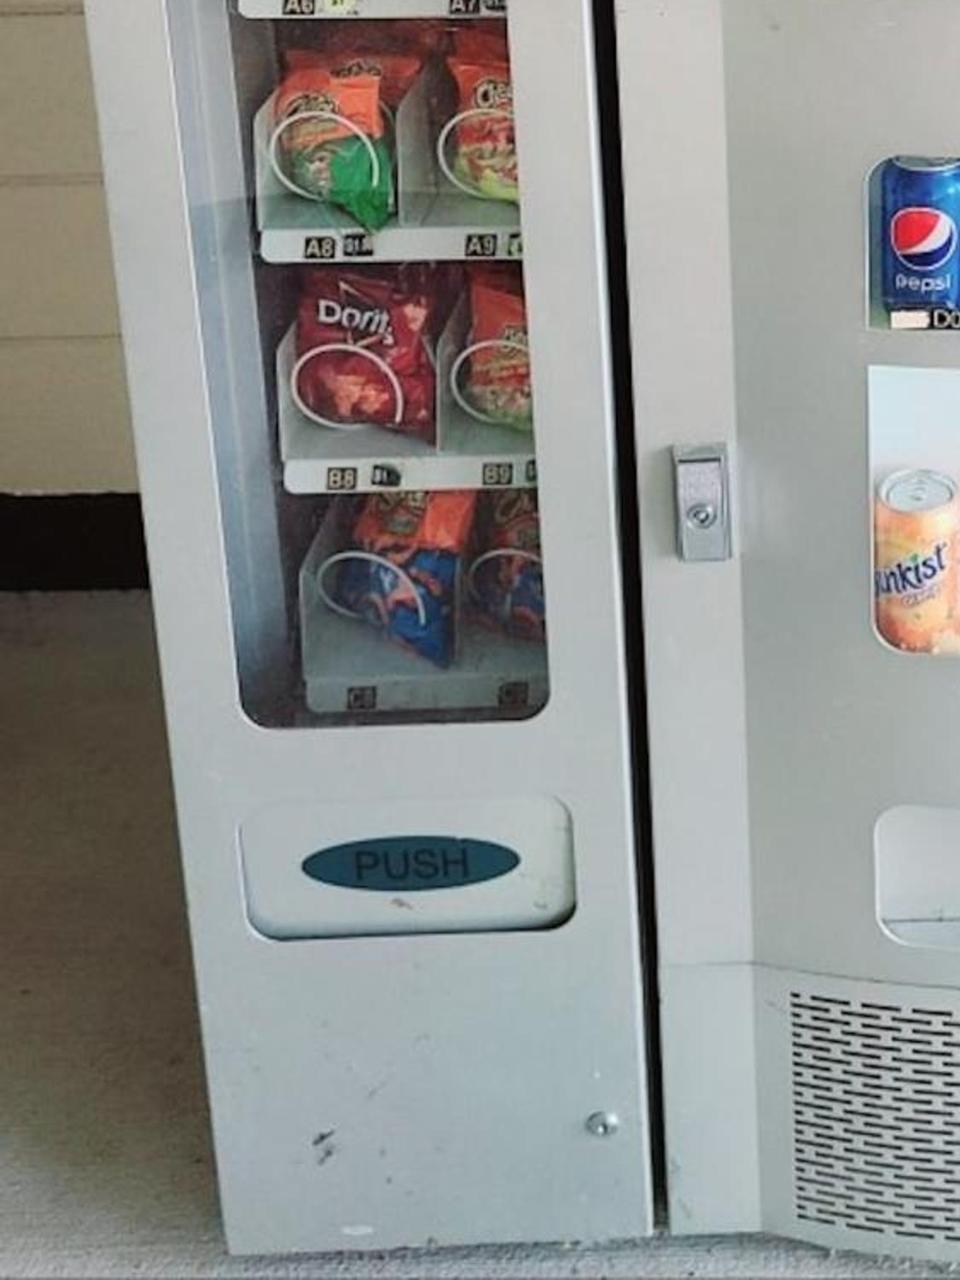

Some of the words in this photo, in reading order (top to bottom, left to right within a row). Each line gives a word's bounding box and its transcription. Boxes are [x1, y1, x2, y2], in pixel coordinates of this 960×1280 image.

[306, 240, 335, 256] A8
[317, 298, 394, 345] Dorits
[329, 469, 356, 488] B8
[354, 848, 469, 881] PUSH
